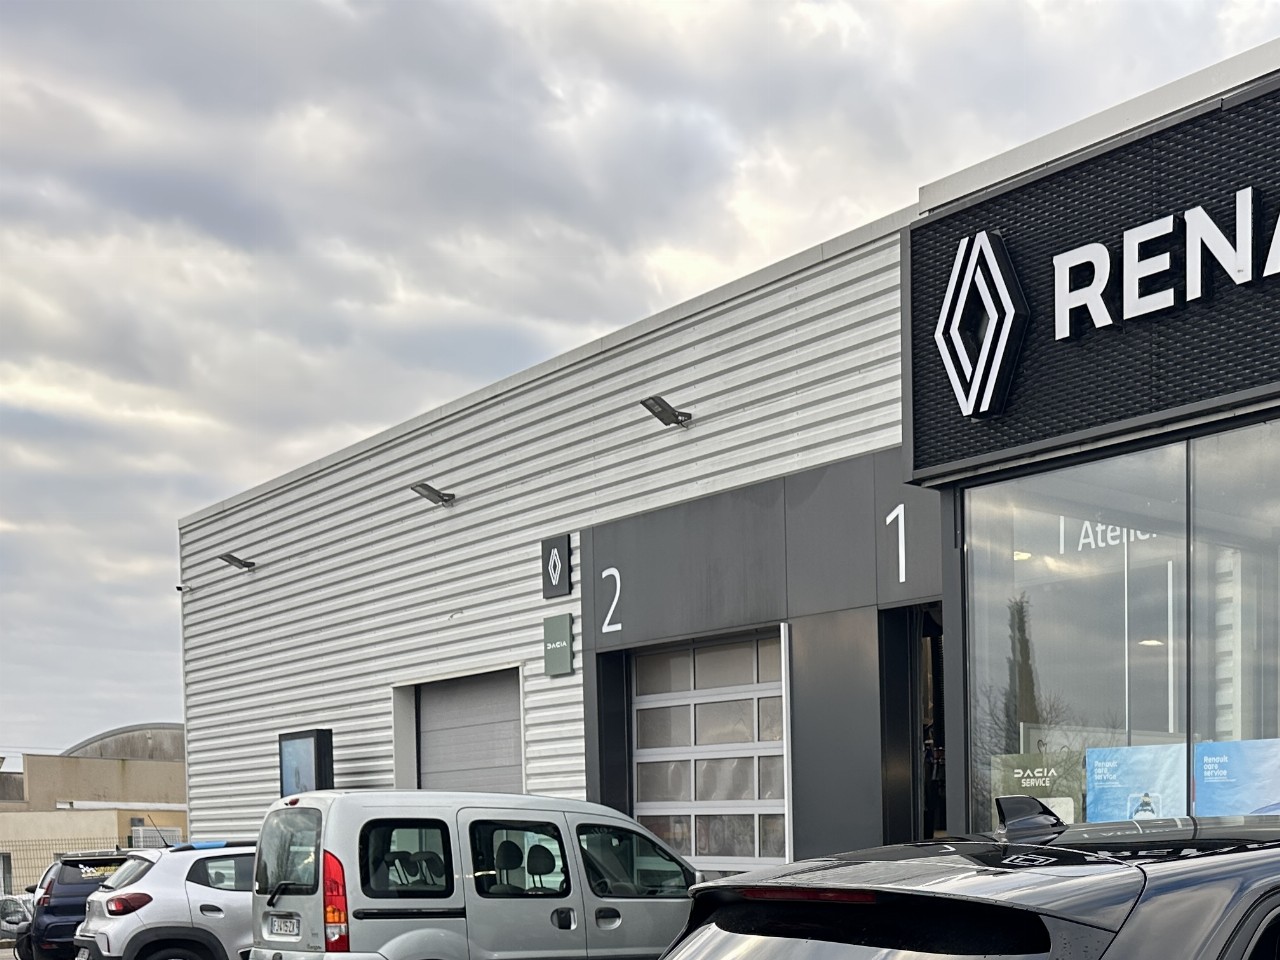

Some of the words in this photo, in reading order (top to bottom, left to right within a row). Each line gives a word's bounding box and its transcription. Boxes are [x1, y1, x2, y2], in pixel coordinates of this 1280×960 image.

[886, 503, 906, 583] 1
[601, 567, 622, 633] 2
[546, 640, 567, 650] DACIA
[1204, 755, 1228, 763] Renault
[1014, 768, 1058, 778] DACIA
[1021, 778, 1050, 787] SERVICE
